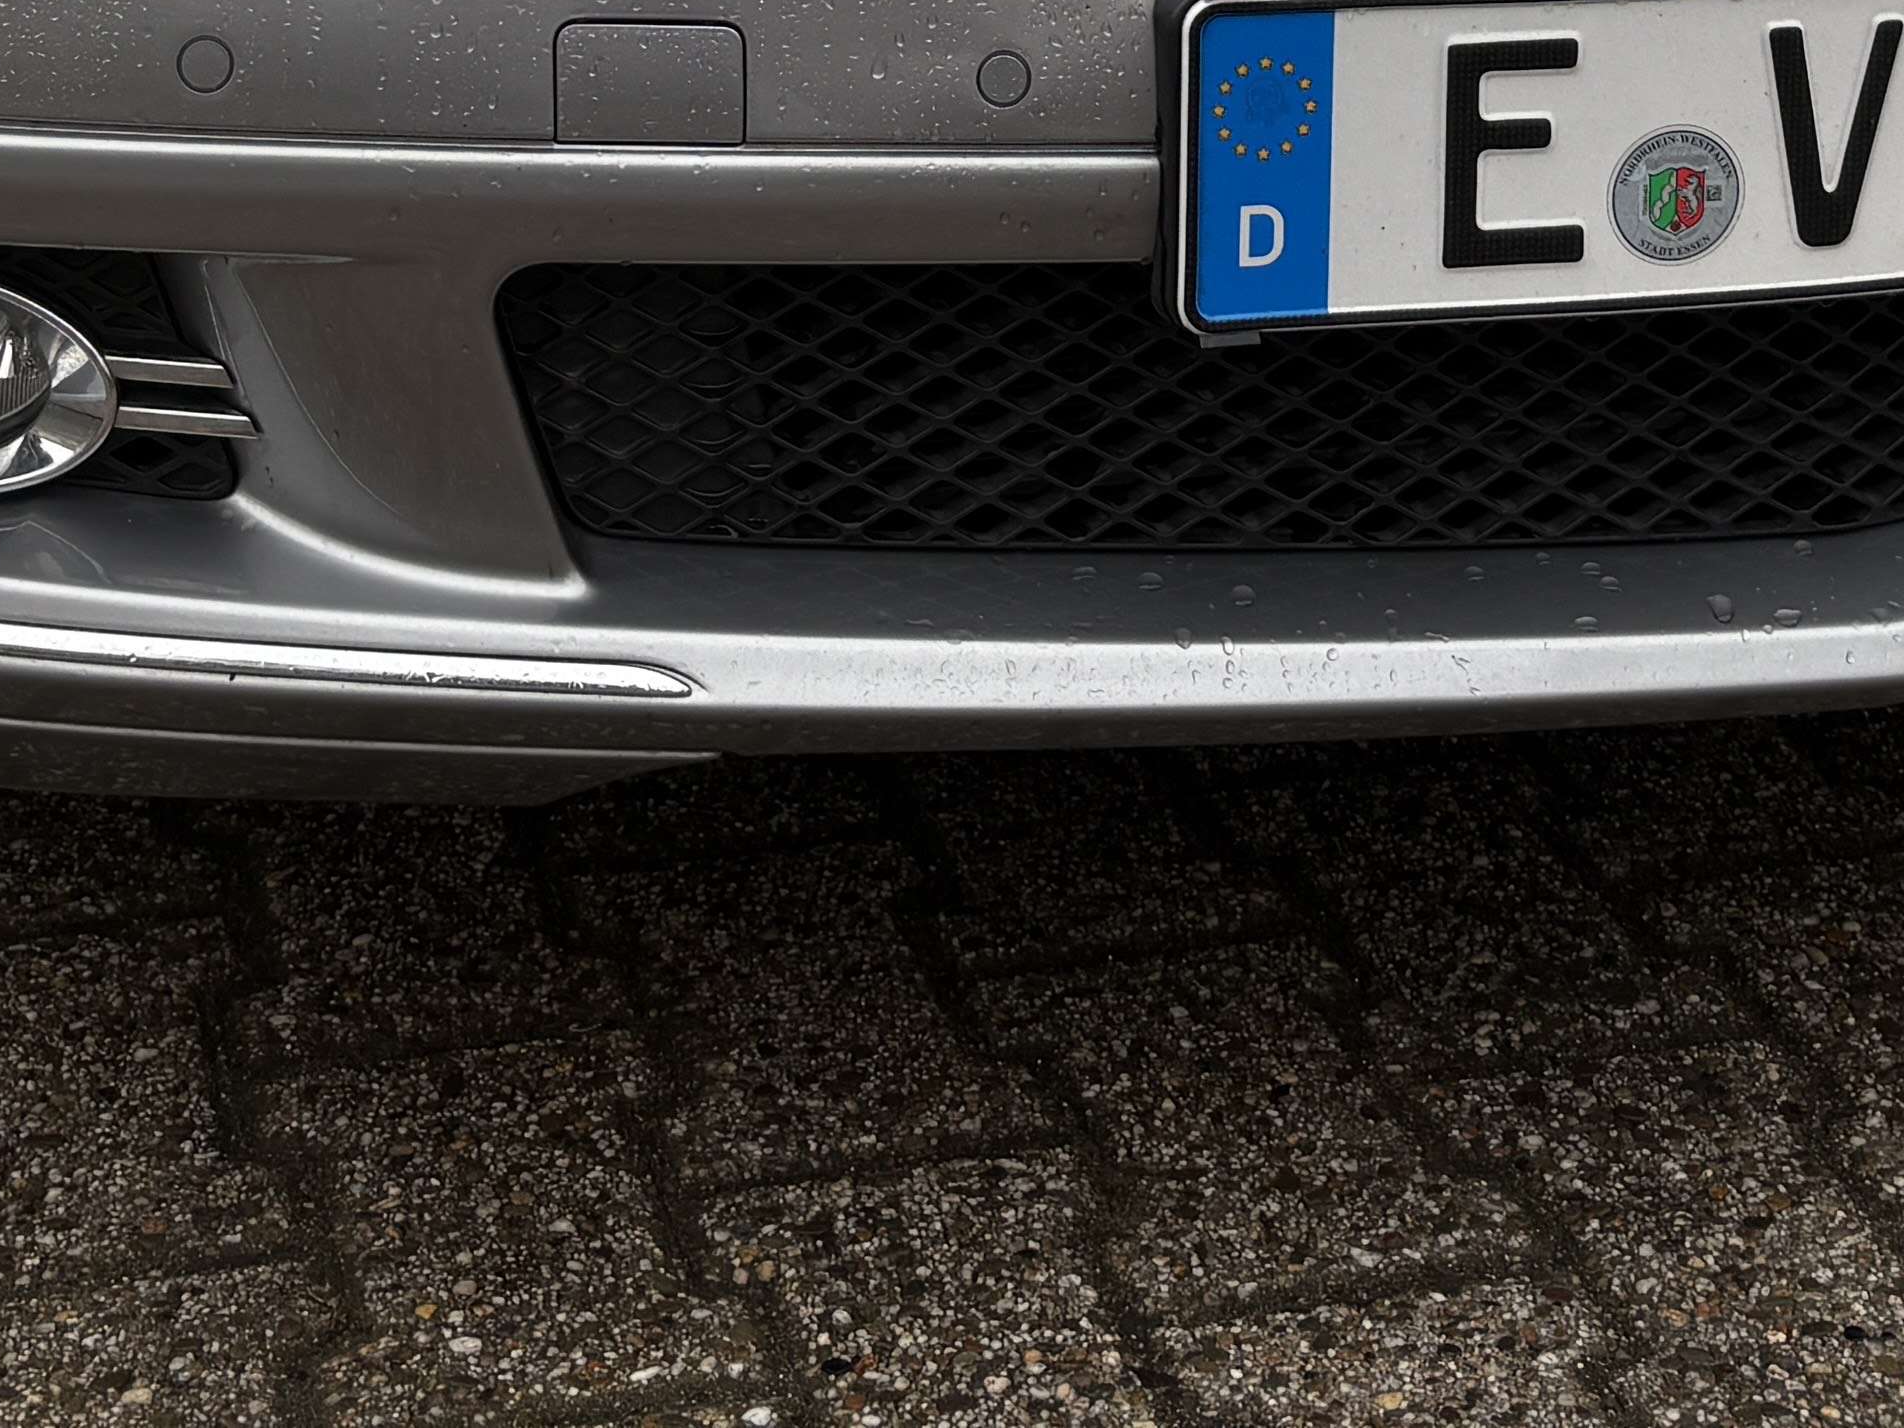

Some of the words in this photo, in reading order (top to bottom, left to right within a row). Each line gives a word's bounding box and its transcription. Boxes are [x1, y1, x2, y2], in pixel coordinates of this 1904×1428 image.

[1442, 37, 1585, 269] E
[1618, 133, 1734, 186] NORDRHEIN-WESTFALEN
[1238, 204, 1285, 267] D
[1638, 239, 1674, 256] STADT
[1676, 234, 1712, 256] ESSEN
